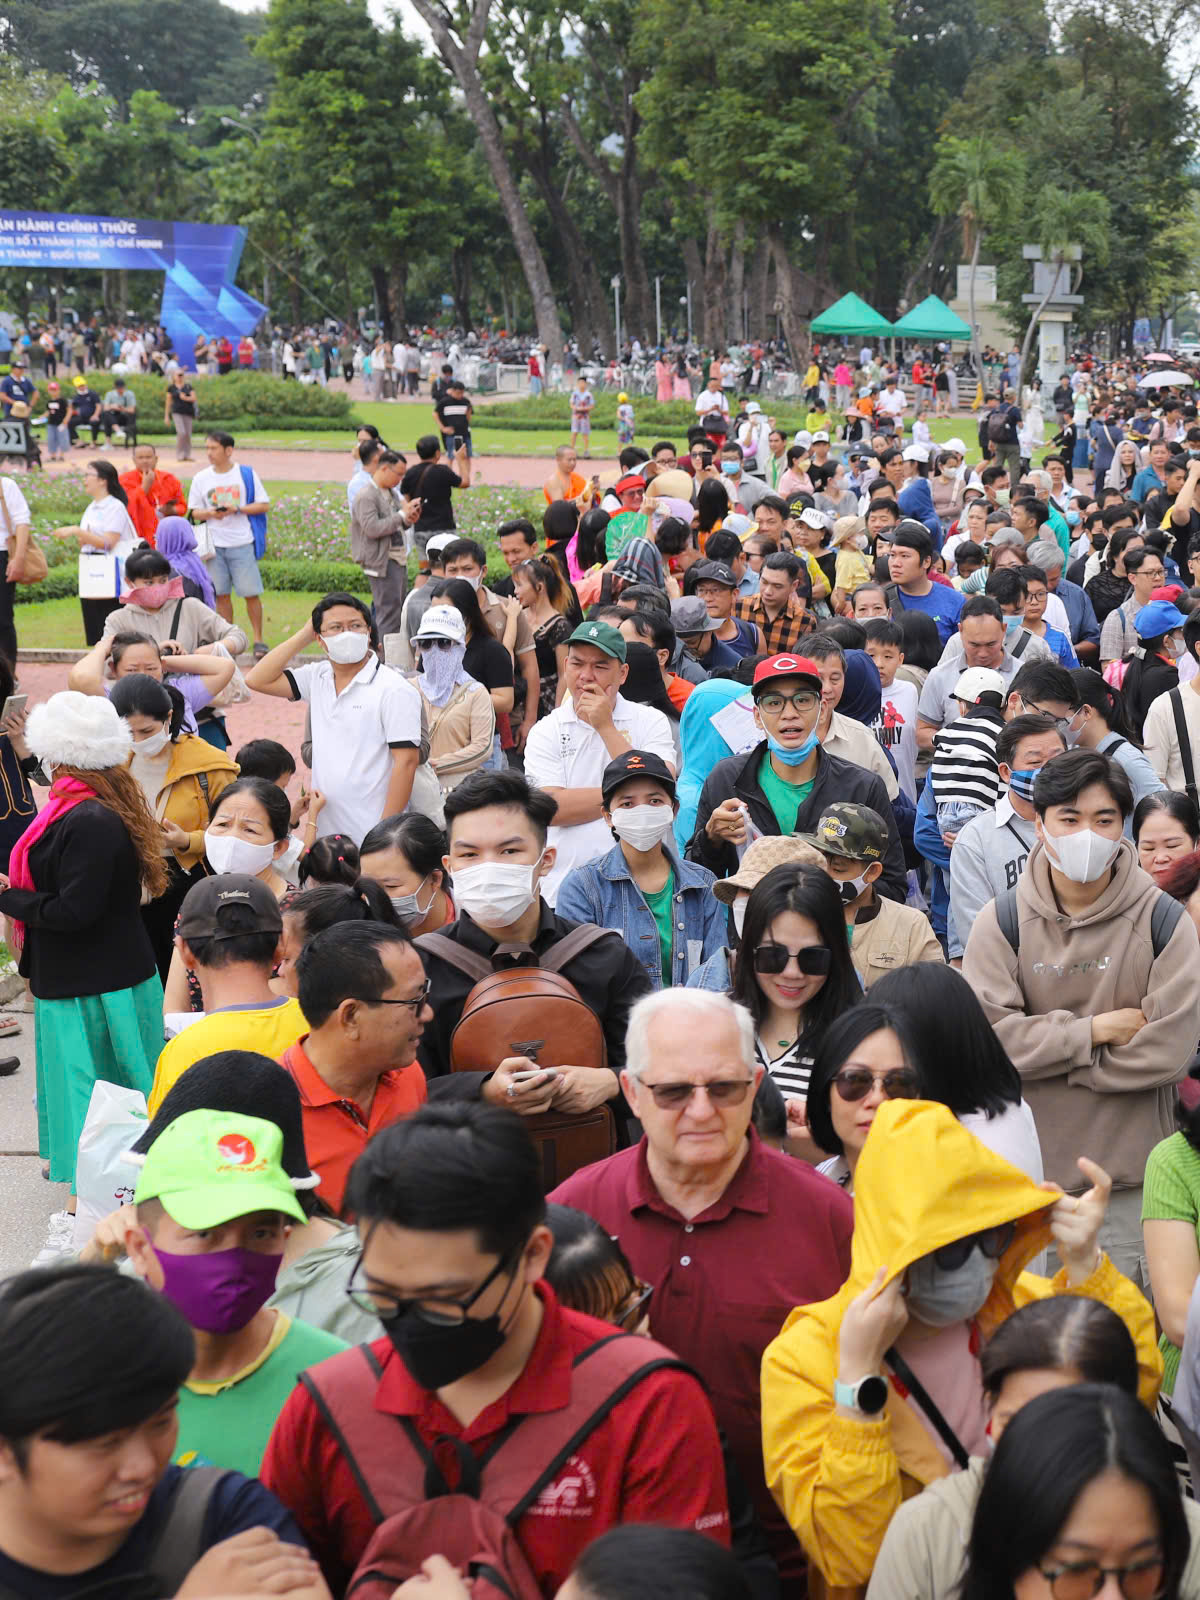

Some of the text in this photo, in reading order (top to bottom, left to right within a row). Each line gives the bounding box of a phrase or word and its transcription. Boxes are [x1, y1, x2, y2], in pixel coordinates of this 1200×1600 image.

[16, 217, 55, 232] HÀNH
[56, 219, 98, 233] CHÍNH
[99, 220, 137, 234] THỨC
